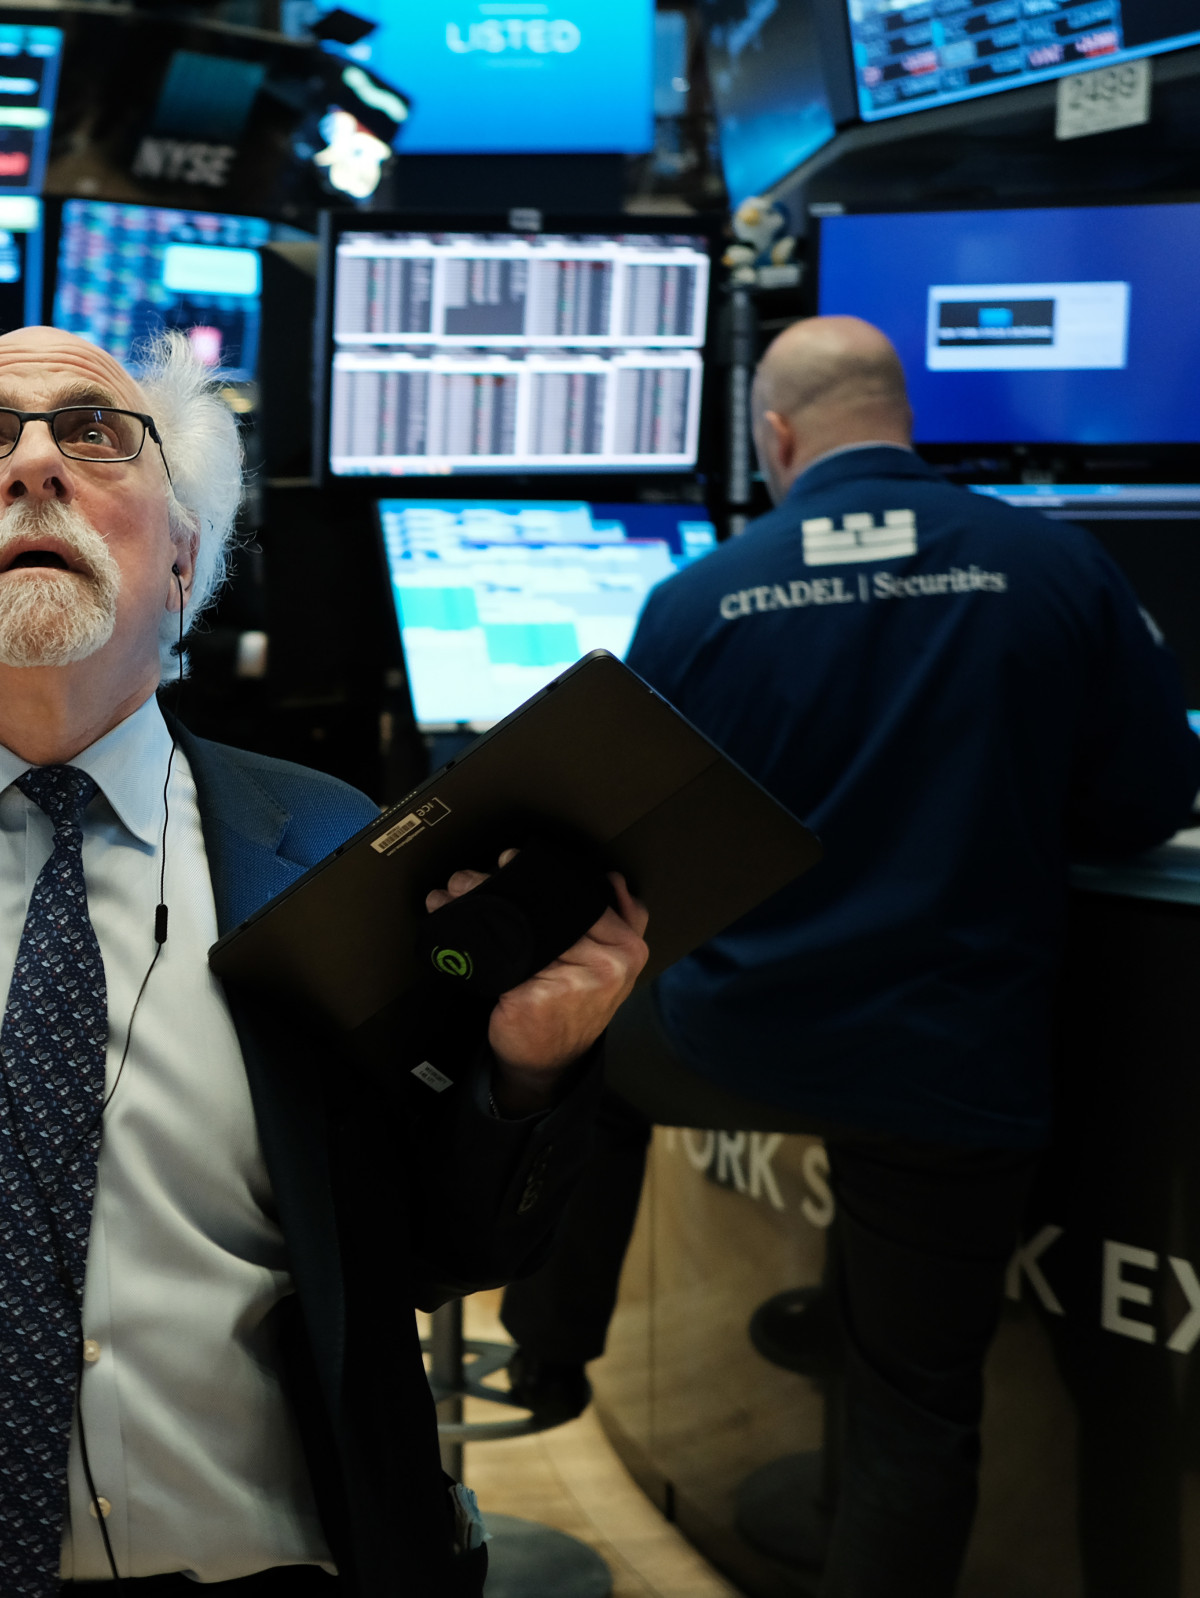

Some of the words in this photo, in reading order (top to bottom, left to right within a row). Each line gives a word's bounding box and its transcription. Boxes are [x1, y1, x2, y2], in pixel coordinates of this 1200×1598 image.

[445, 19, 581, 54] LISTED
[131, 135, 237, 186] NYSE
[719, 577, 855, 620] CITADEL
[872, 563, 1008, 600] Securities
